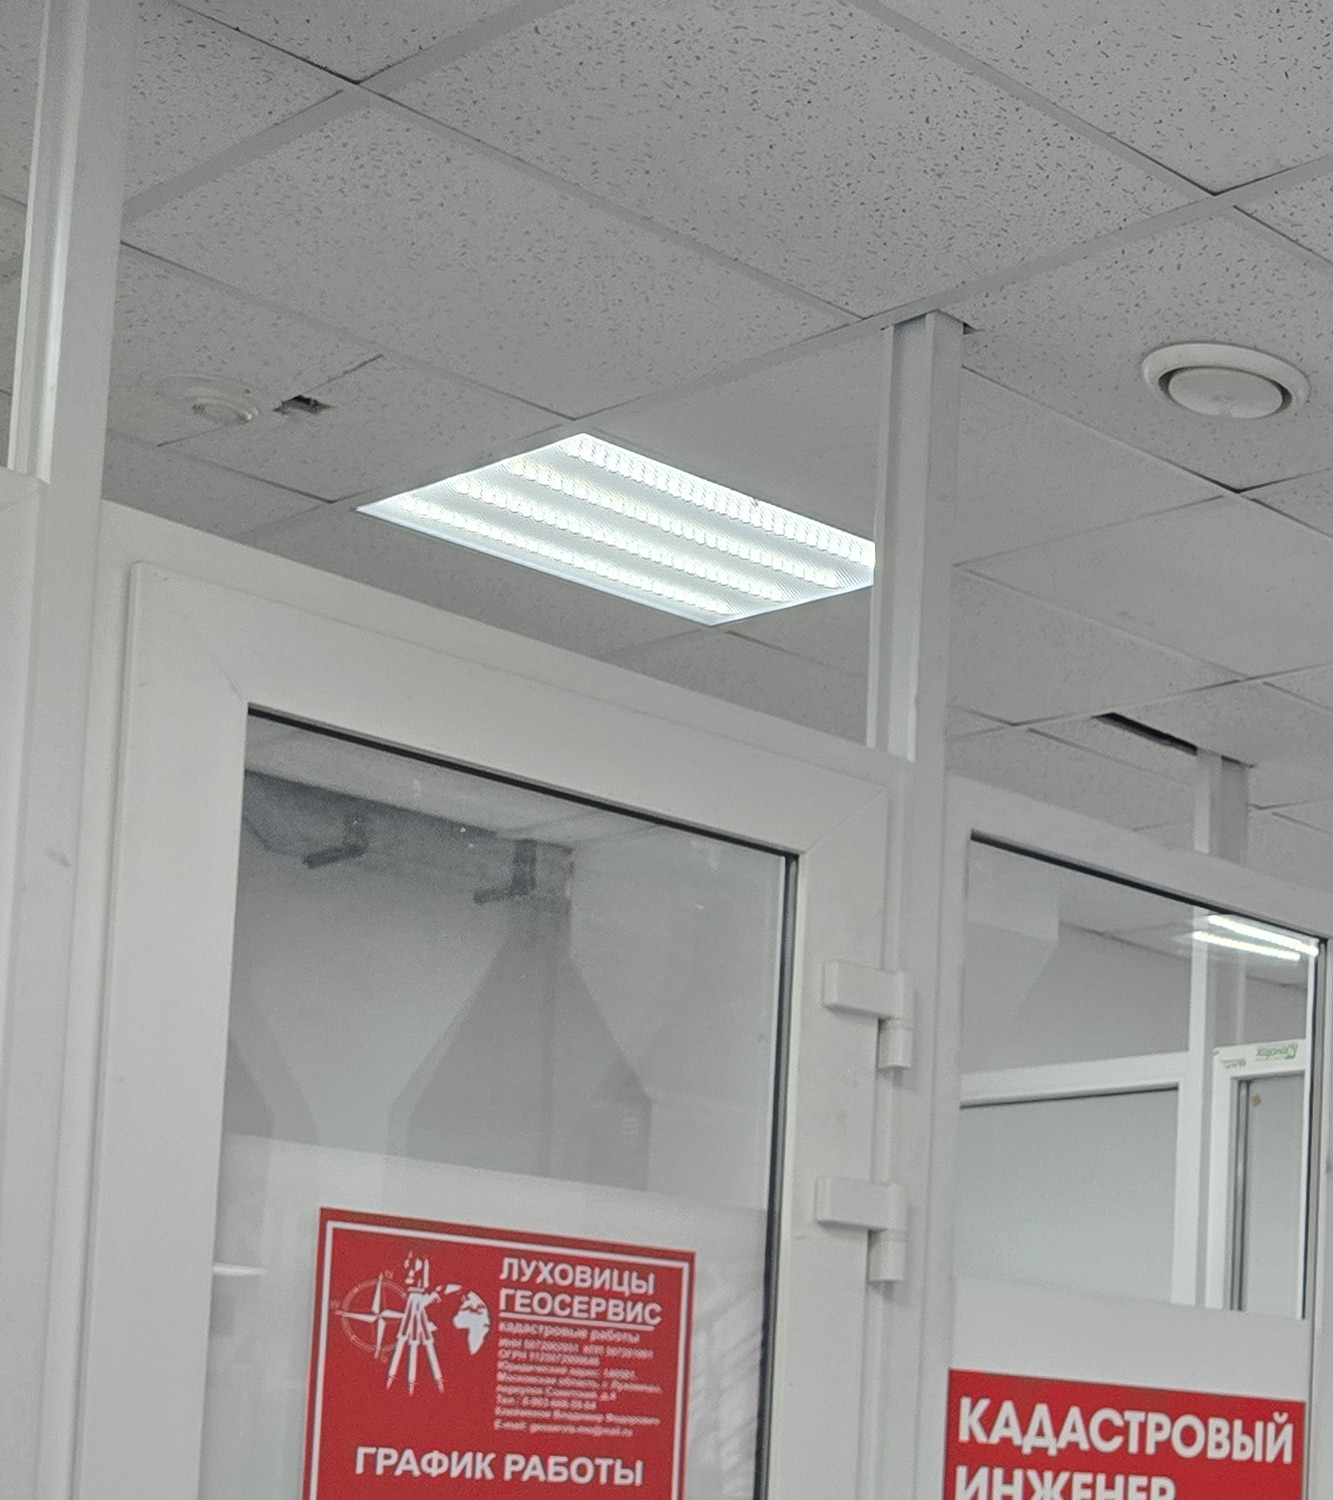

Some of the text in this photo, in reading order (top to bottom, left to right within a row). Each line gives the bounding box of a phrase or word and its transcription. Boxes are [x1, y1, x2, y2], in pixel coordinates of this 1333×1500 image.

[500, 1257, 655, 1297] ЛУХОВИЦЫ
[500, 1287, 662, 1325] ГЕОСЕРВИС
[957, 1395, 1294, 1465] КАДАСТРОВЫЙ
[355, 1445, 644, 1486] ГРАФИК РАБОТЫ
